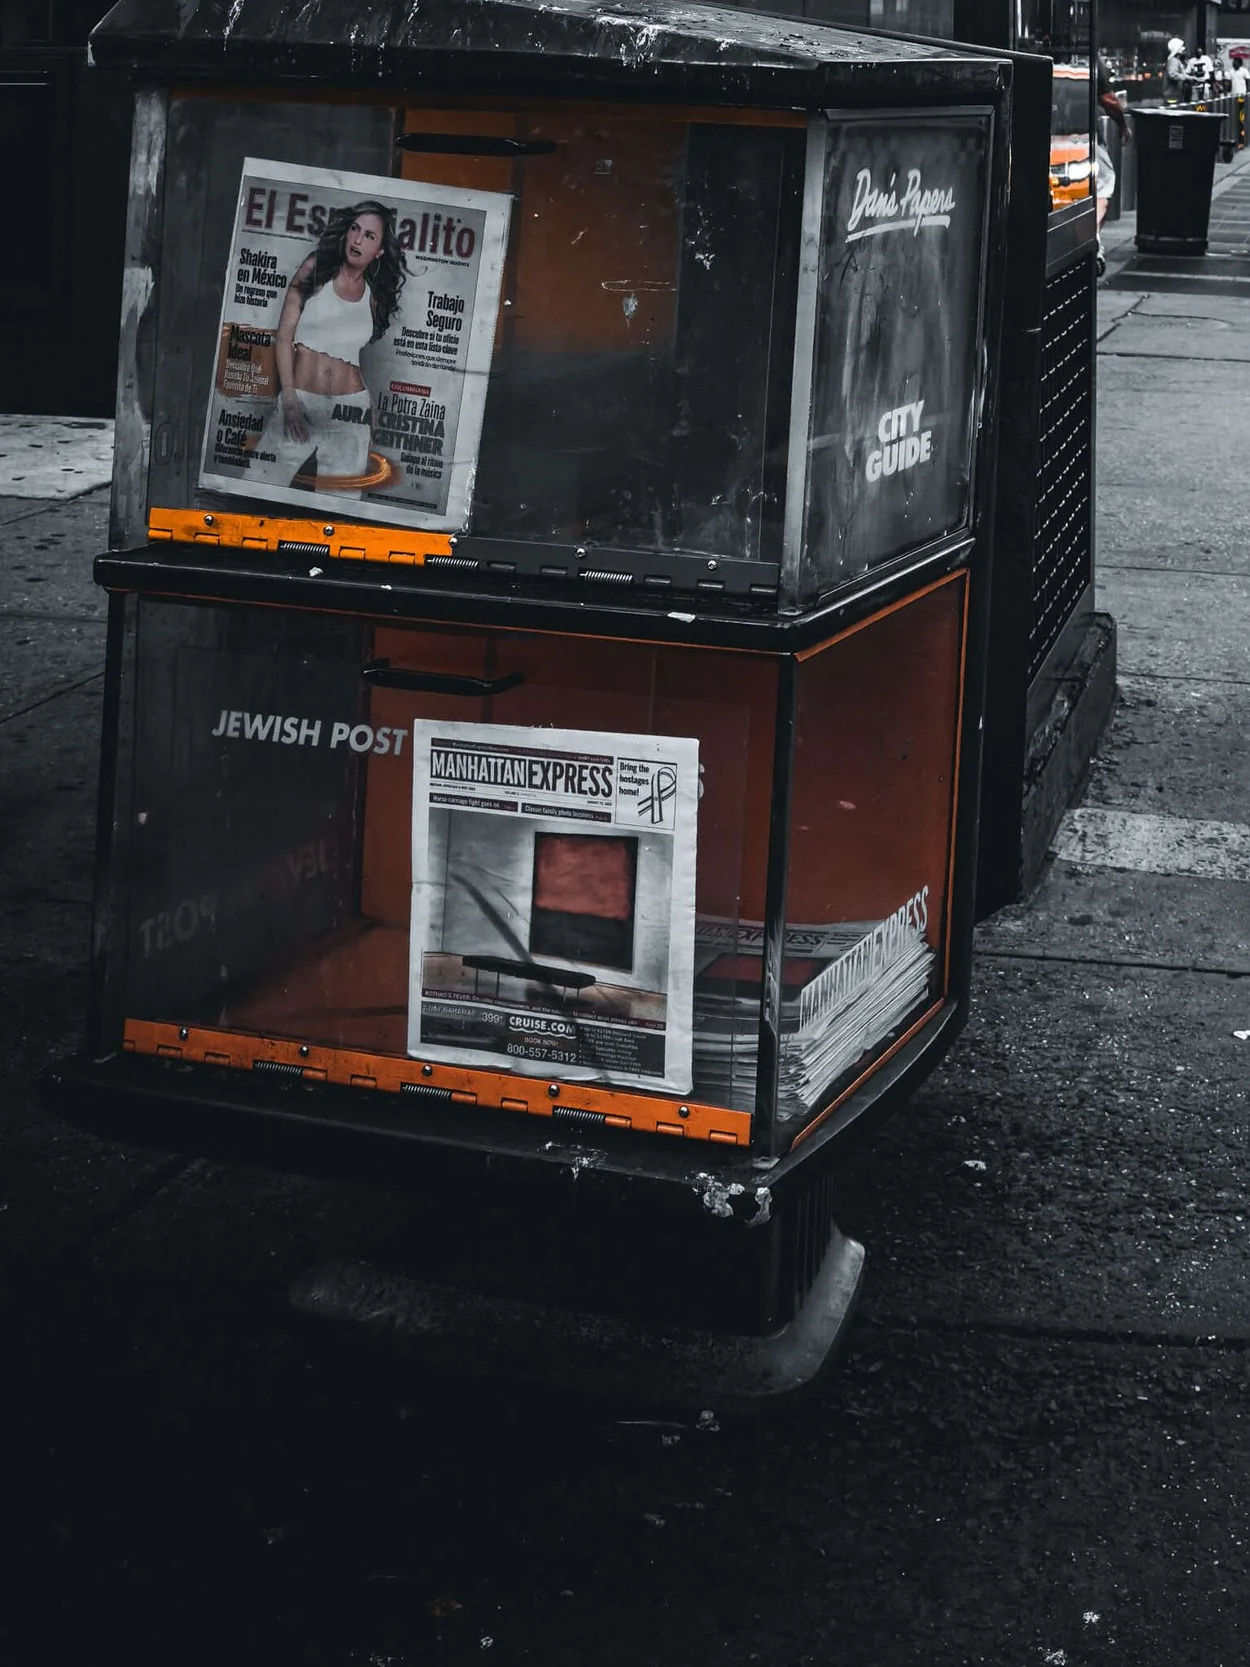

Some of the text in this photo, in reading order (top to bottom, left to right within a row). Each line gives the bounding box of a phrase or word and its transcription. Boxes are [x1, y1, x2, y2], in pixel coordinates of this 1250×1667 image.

[245, 187, 276, 229] El
[848, 167, 956, 236] Dan's Papers
[240, 248, 278, 269] Shakira
[237, 267, 288, 289] en México
[234, 293, 268, 308] hizo historia
[235, 282, 278, 299] Un regreso que
[427, 290, 465, 315] Trabajo
[426, 310, 463, 332] Seguro
[230, 325, 271, 347] Mascota
[401, 326, 460, 345] Descubre si tu oficio
[228, 342, 252, 362] Ideal
[393, 337, 458, 356] está en esta lista clave
[396, 349, 425, 361] Profesiones
[425, 354, 436, 362] que
[378, 391, 446, 420] La Potra Zaina
[218, 408, 264, 433] Ansiedad
[331, 403, 445, 439] AURA CRISTINA
[878, 400, 925, 444] CITY
[216, 427, 247, 447] o Café
[244, 448, 259, 460] entre
[259, 450, 277, 463] alerta
[421, 454, 427, 466] al
[427, 455, 444, 469] ritmo
[865, 430, 932, 484] GUIDE
[405, 464, 442, 479] de la música
[212, 709, 408, 756] JEWISH POST
[430, 751, 614, 799] MANHATTAN EXPRESS
[620, 762, 650, 774] Bring the
[619, 773, 650, 786] hostages
[618, 785, 639, 797] home!
[468, 799, 481, 807] fight
[524, 804, 542, 813] Classic
[542, 807, 558, 816] family
[557, 809, 572, 818] photo
[572, 811, 594, 819] business
[509, 1016, 577, 1034] CRUISE.COM
[523, 1036, 542, 1045] BOOK
[506, 1043, 577, 1063] 800-557-5312
